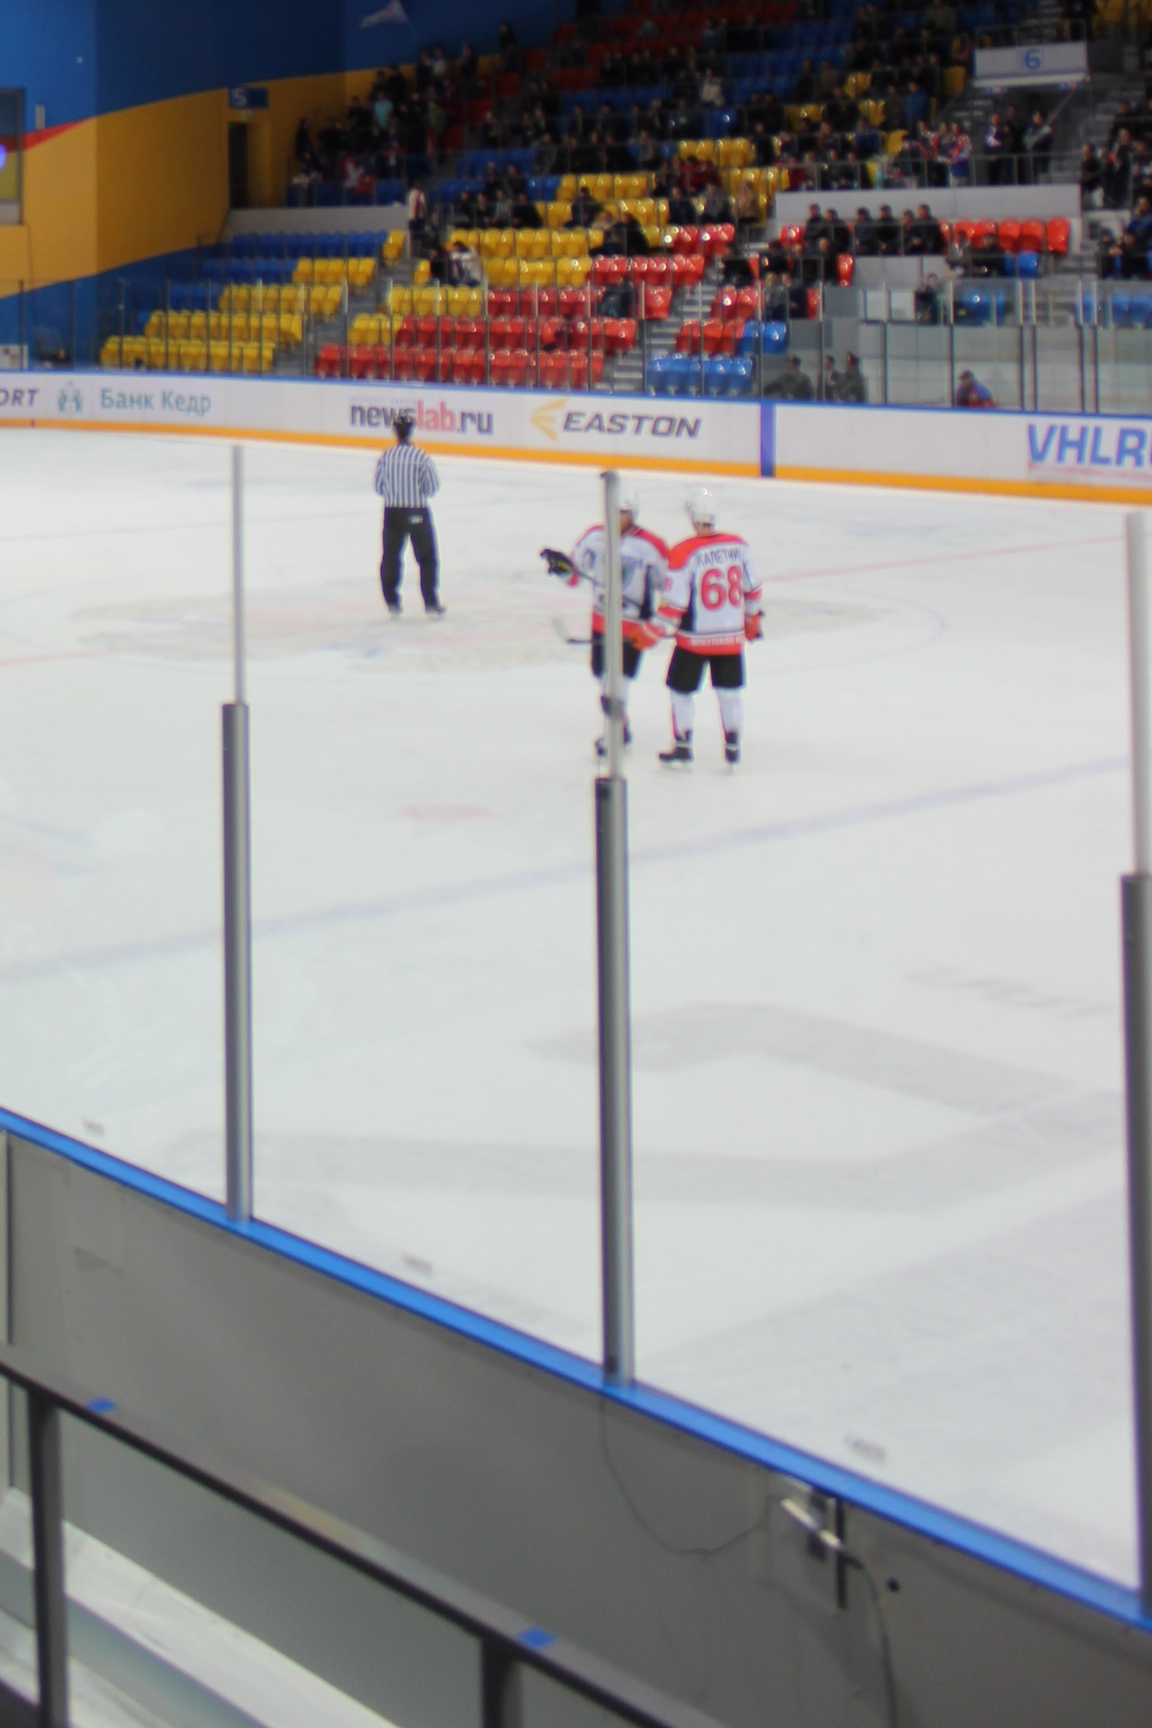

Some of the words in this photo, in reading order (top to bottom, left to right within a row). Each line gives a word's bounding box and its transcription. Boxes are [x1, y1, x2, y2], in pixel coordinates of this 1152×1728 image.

[1025, 49, 1042, 71] 6
[101, 388, 153, 411] Банк
[162, 390, 212, 415] Кедр
[563, 412, 703, 439] EASTON
[1028, 423, 1152, 469] VHLR
[701, 565, 743, 611] 68
